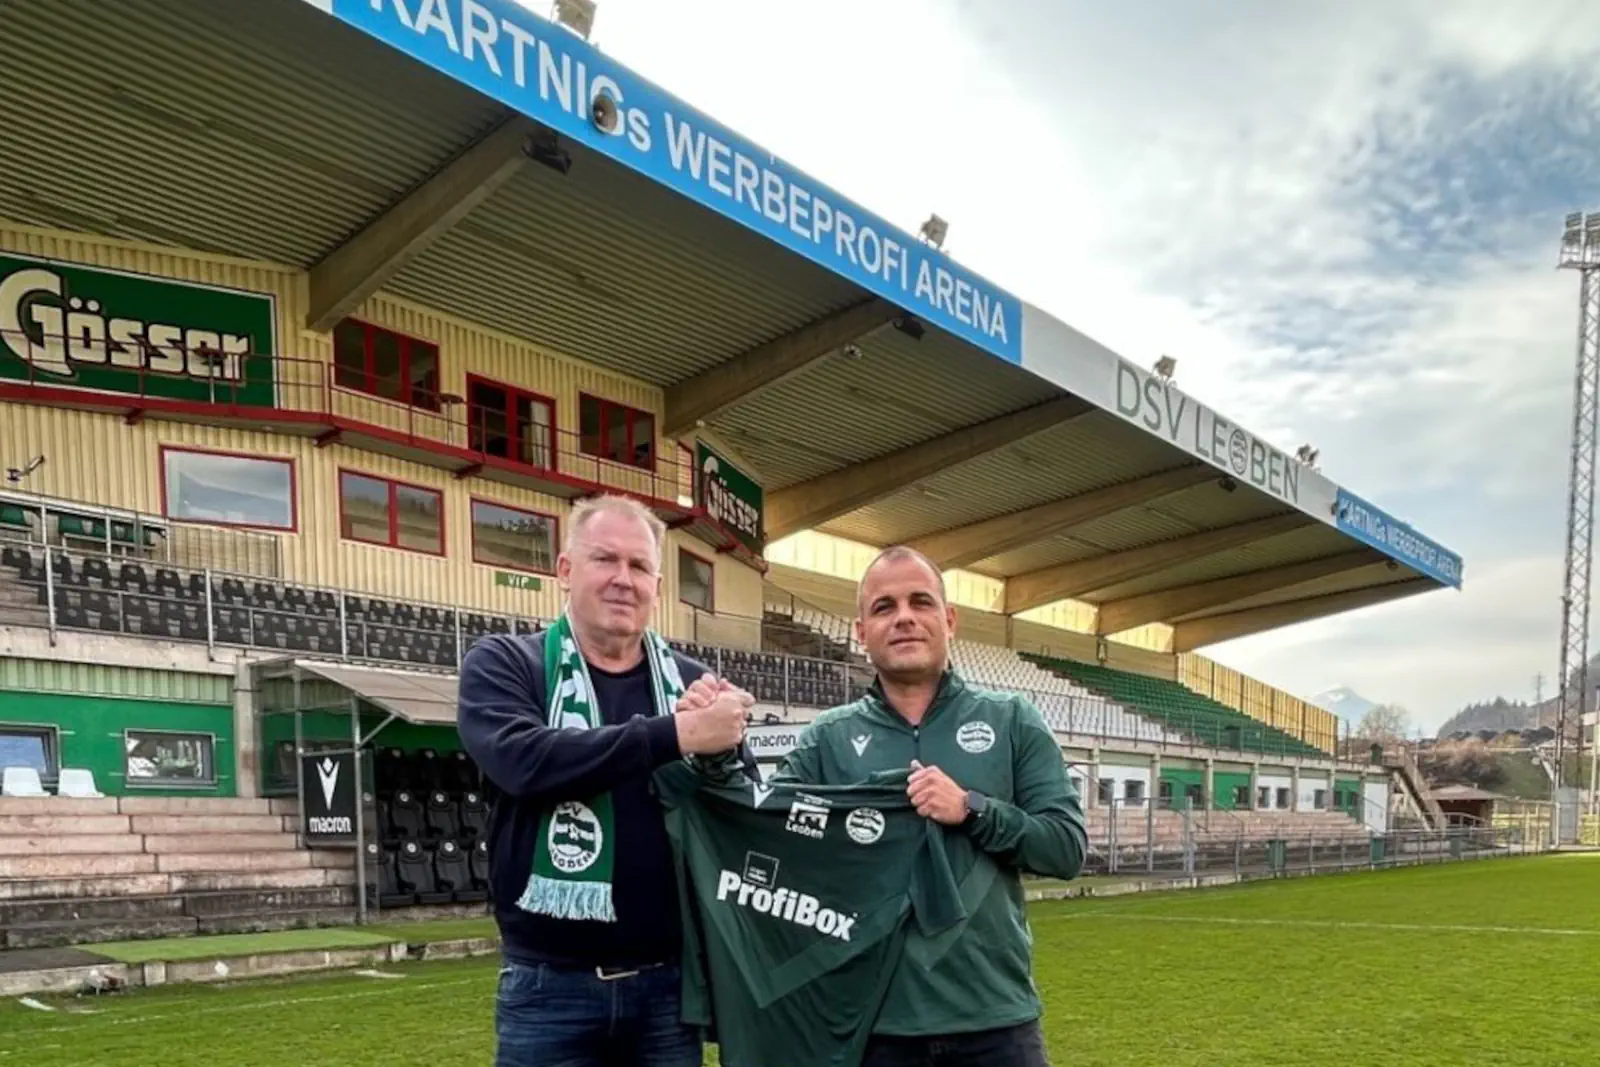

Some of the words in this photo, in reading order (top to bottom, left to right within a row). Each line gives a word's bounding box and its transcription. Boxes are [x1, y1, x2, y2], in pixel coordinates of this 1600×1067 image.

[370, 0, 651, 152] ARTNIGs
[664, 112, 909, 291] WERBEPROFI
[914, 258, 1008, 344] ARENA
[0, 268, 249, 380] Gösser
[1117, 360, 1186, 441] DSV
[508, 574, 530, 589] VIP
[749, 734, 797, 747] macron
[309, 816, 352, 833] macron
[716, 869, 856, 942] ProfiBox
